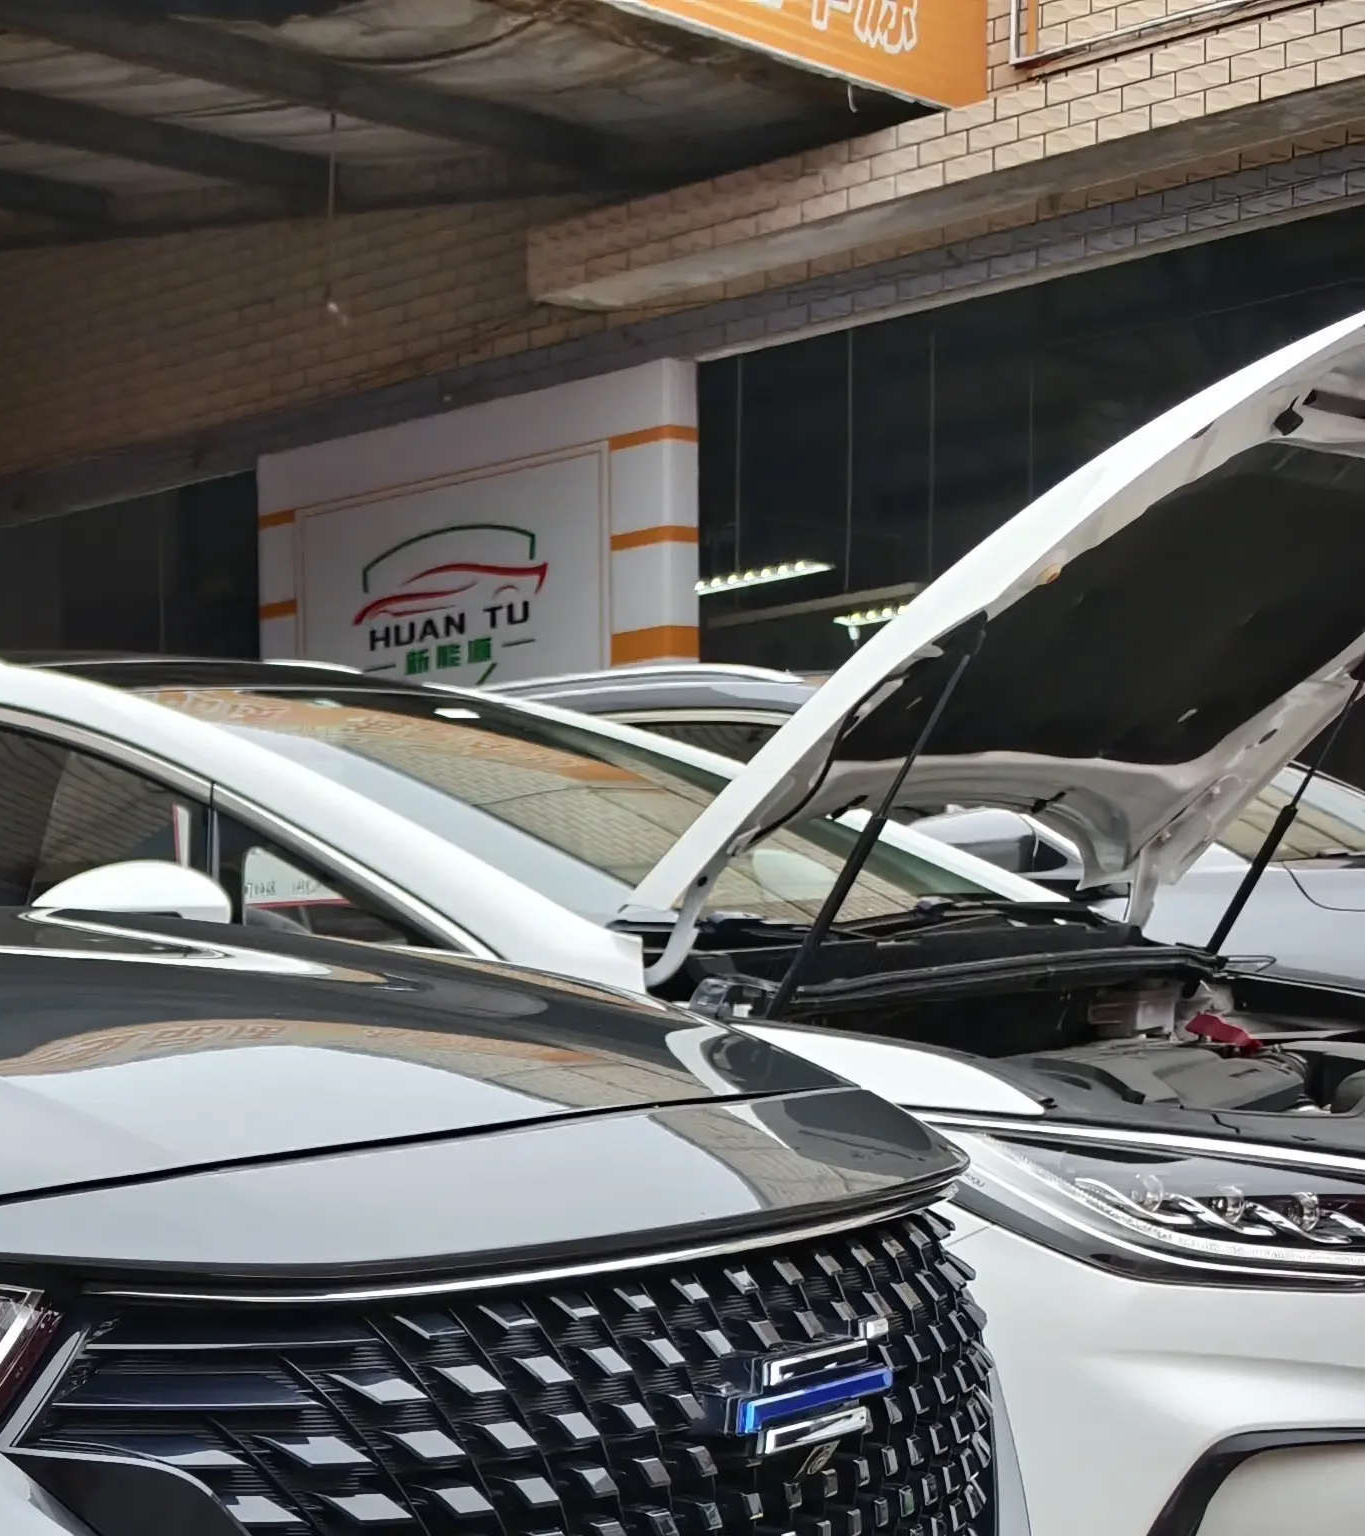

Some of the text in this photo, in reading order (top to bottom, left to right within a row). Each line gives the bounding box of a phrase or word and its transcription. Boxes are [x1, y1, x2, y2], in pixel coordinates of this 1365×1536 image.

[369, 600, 530, 651] HUAN TU
[405, 637, 492, 676] 新能源
